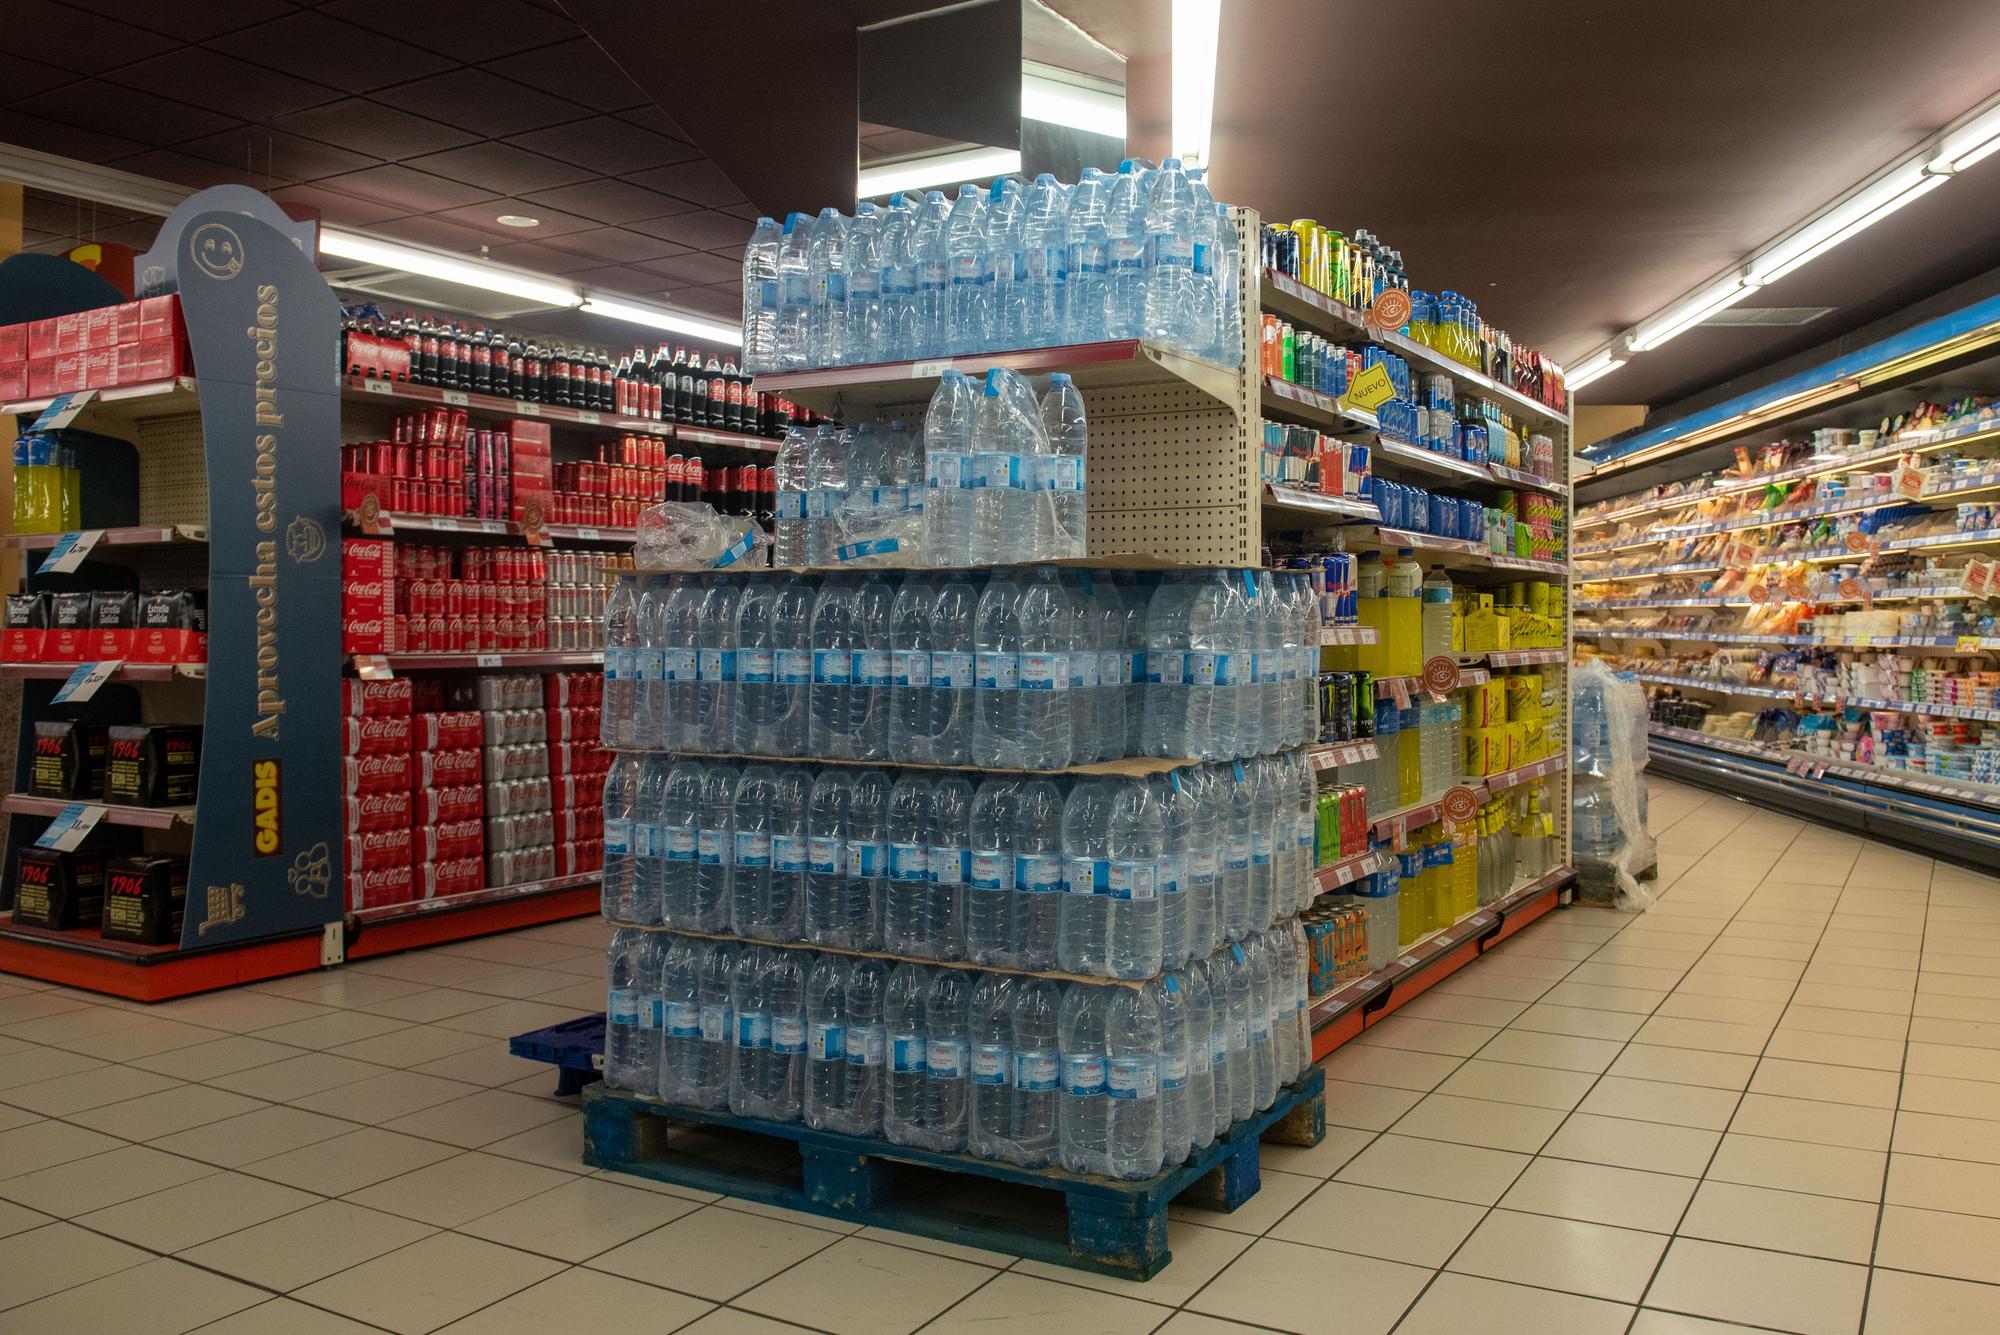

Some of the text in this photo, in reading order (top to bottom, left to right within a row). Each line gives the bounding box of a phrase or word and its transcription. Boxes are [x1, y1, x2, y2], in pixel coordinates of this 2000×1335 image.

[1354, 378, 1386, 400] NUEVO
[248, 284, 286, 742] Aprovecha estos precios
[349, 543, 382, 558] Coca-Cola
[348, 581, 382, 596] Coca-Cola
[348, 619, 382, 633] Coca-Cola
[364, 681, 411, 699] Coca-Cola
[361, 719, 408, 739] Coca-Cola
[35, 738, 65, 755] 1906
[111, 740, 142, 760] 1906
[359, 754, 408, 776] Coca-Cola
[434, 750, 477, 770] Coca-Cola
[360, 794, 407, 815] Coca-Cola
[438, 787, 479, 806] Coca-Cola
[255, 760, 281, 855] GADIS
[364, 829, 411, 849] Coca-Cola
[437, 821, 480, 841] Coca-Cola
[21, 864, 51, 885] 1906
[364, 869, 411, 889] Coca-Cola
[436, 860, 478, 881] Coca-Cola
[111, 875, 145, 896] 1906
